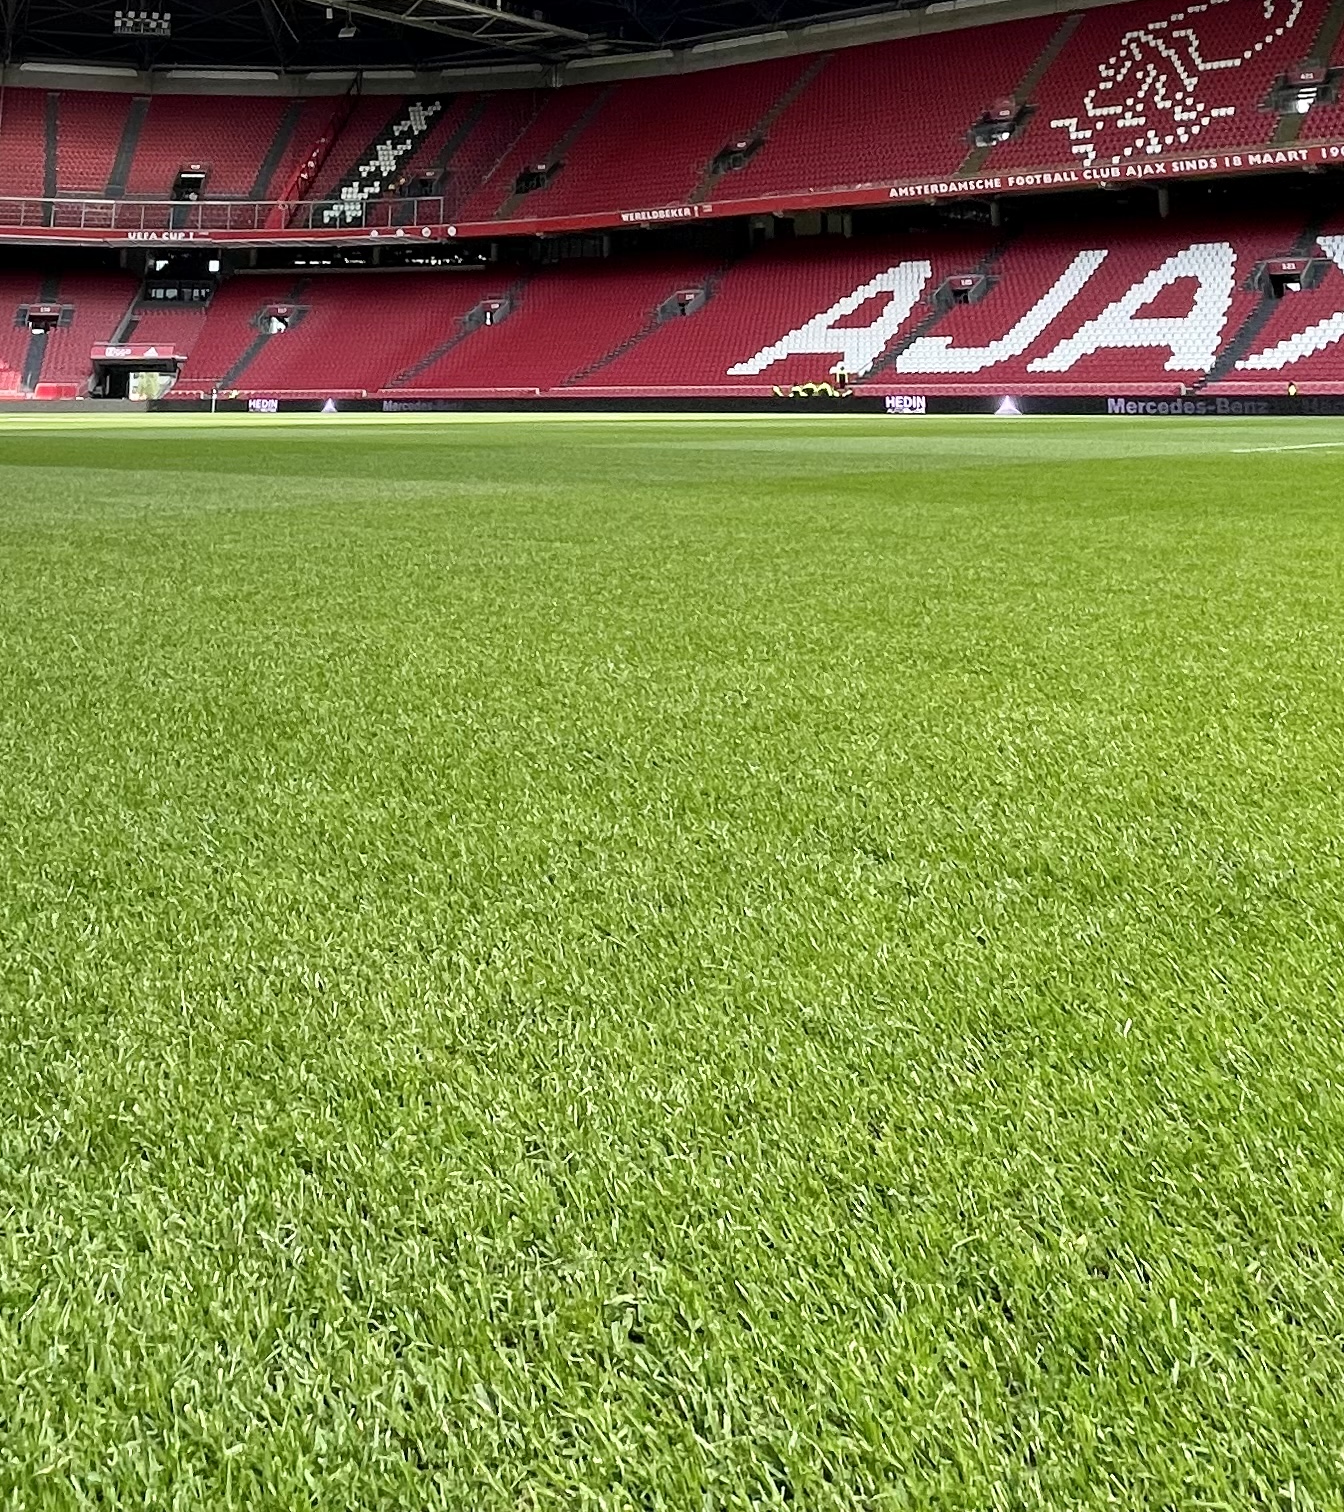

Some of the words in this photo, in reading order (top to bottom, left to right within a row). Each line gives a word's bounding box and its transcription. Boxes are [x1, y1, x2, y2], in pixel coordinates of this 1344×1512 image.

[889, 178, 1002, 198] AMSTERDAMSCHE
[1008, 170, 1079, 187] FOOTBALL
[1082, 165, 1121, 180] CLUB
[1126, 162, 1167, 179] AJAX
[1171, 157, 1218, 173] SINDS
[1224, 155, 1241, 168] 18
[1248, 149, 1309, 165] MAART
[621, 208, 692, 222] WERELDBEKER
[161, 231, 186, 240] CUP
[885, 395, 926, 408] HEDIN
[1107, 397, 1270, 414] Mercedes-Benz
